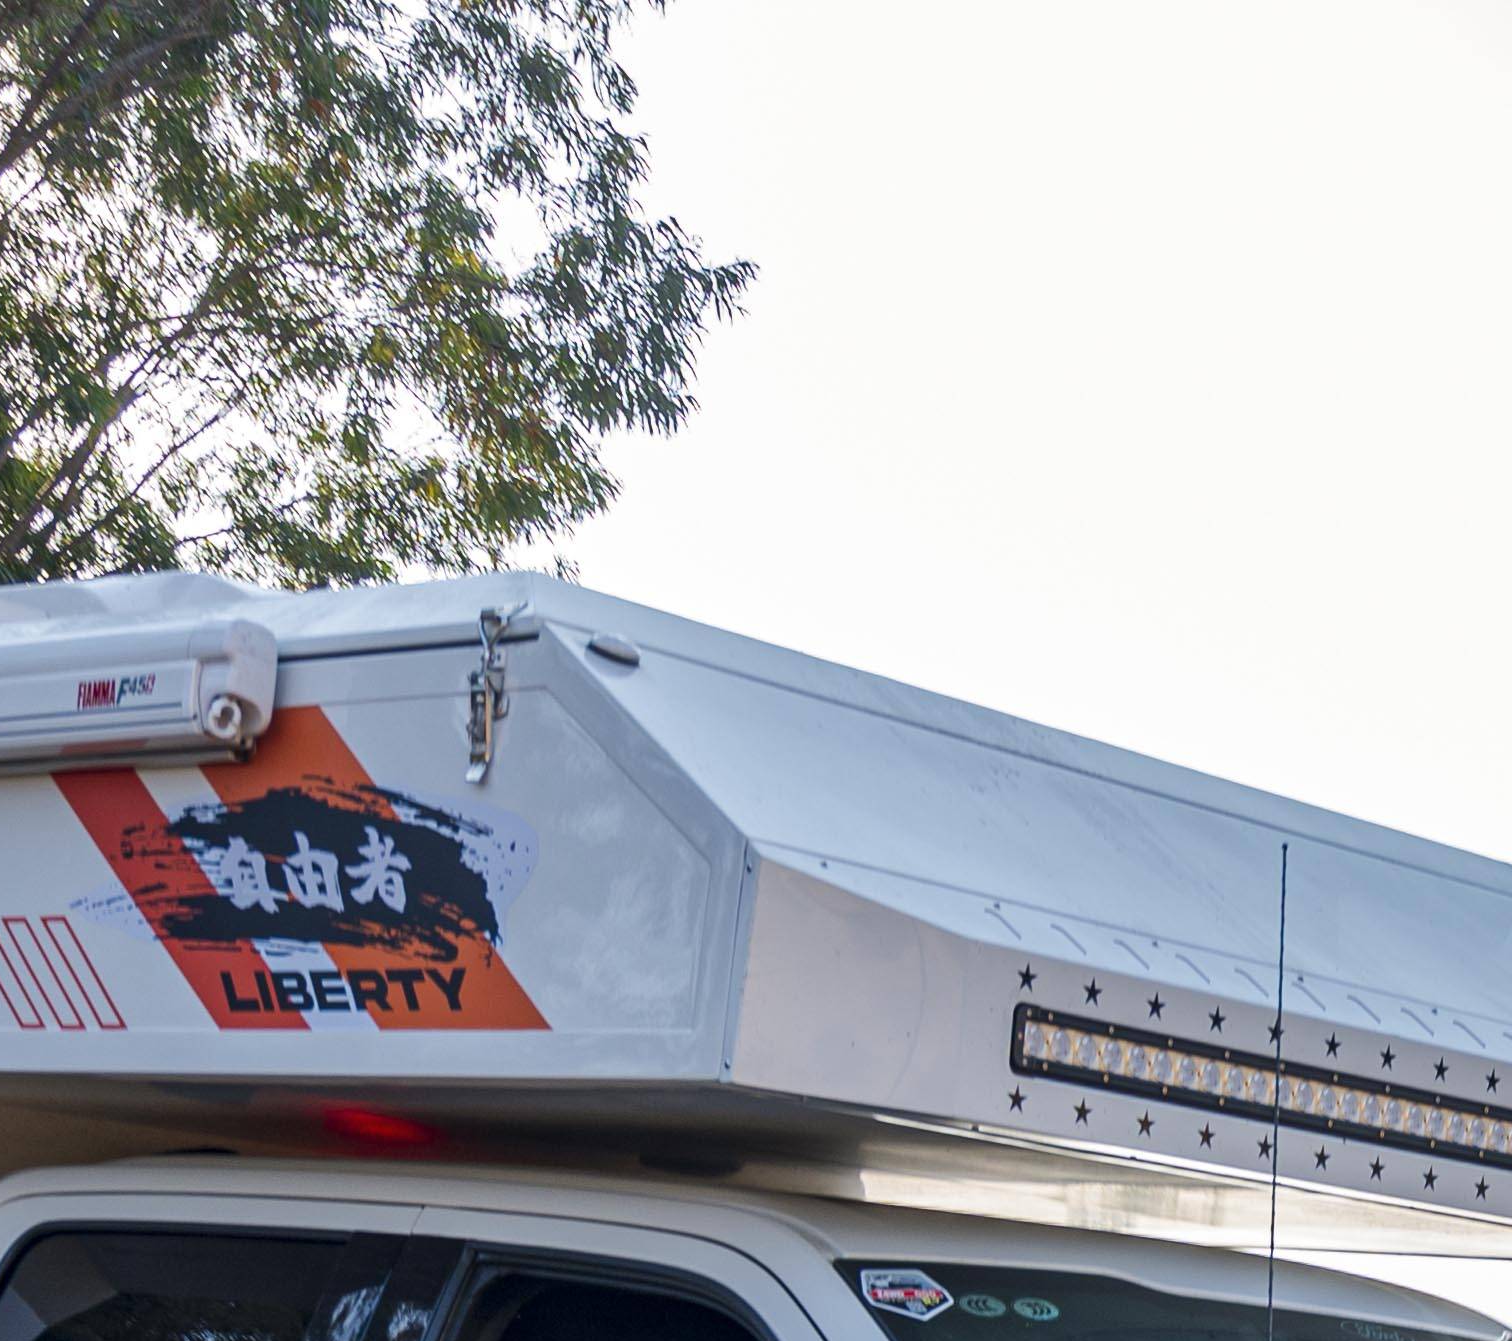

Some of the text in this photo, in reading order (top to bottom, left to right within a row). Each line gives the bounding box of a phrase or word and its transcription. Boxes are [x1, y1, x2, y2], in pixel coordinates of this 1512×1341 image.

[77, 679, 115, 709] FIAMMA
[220, 825, 412, 914] 自由者
[220, 968, 466, 1012] LIBERTY
